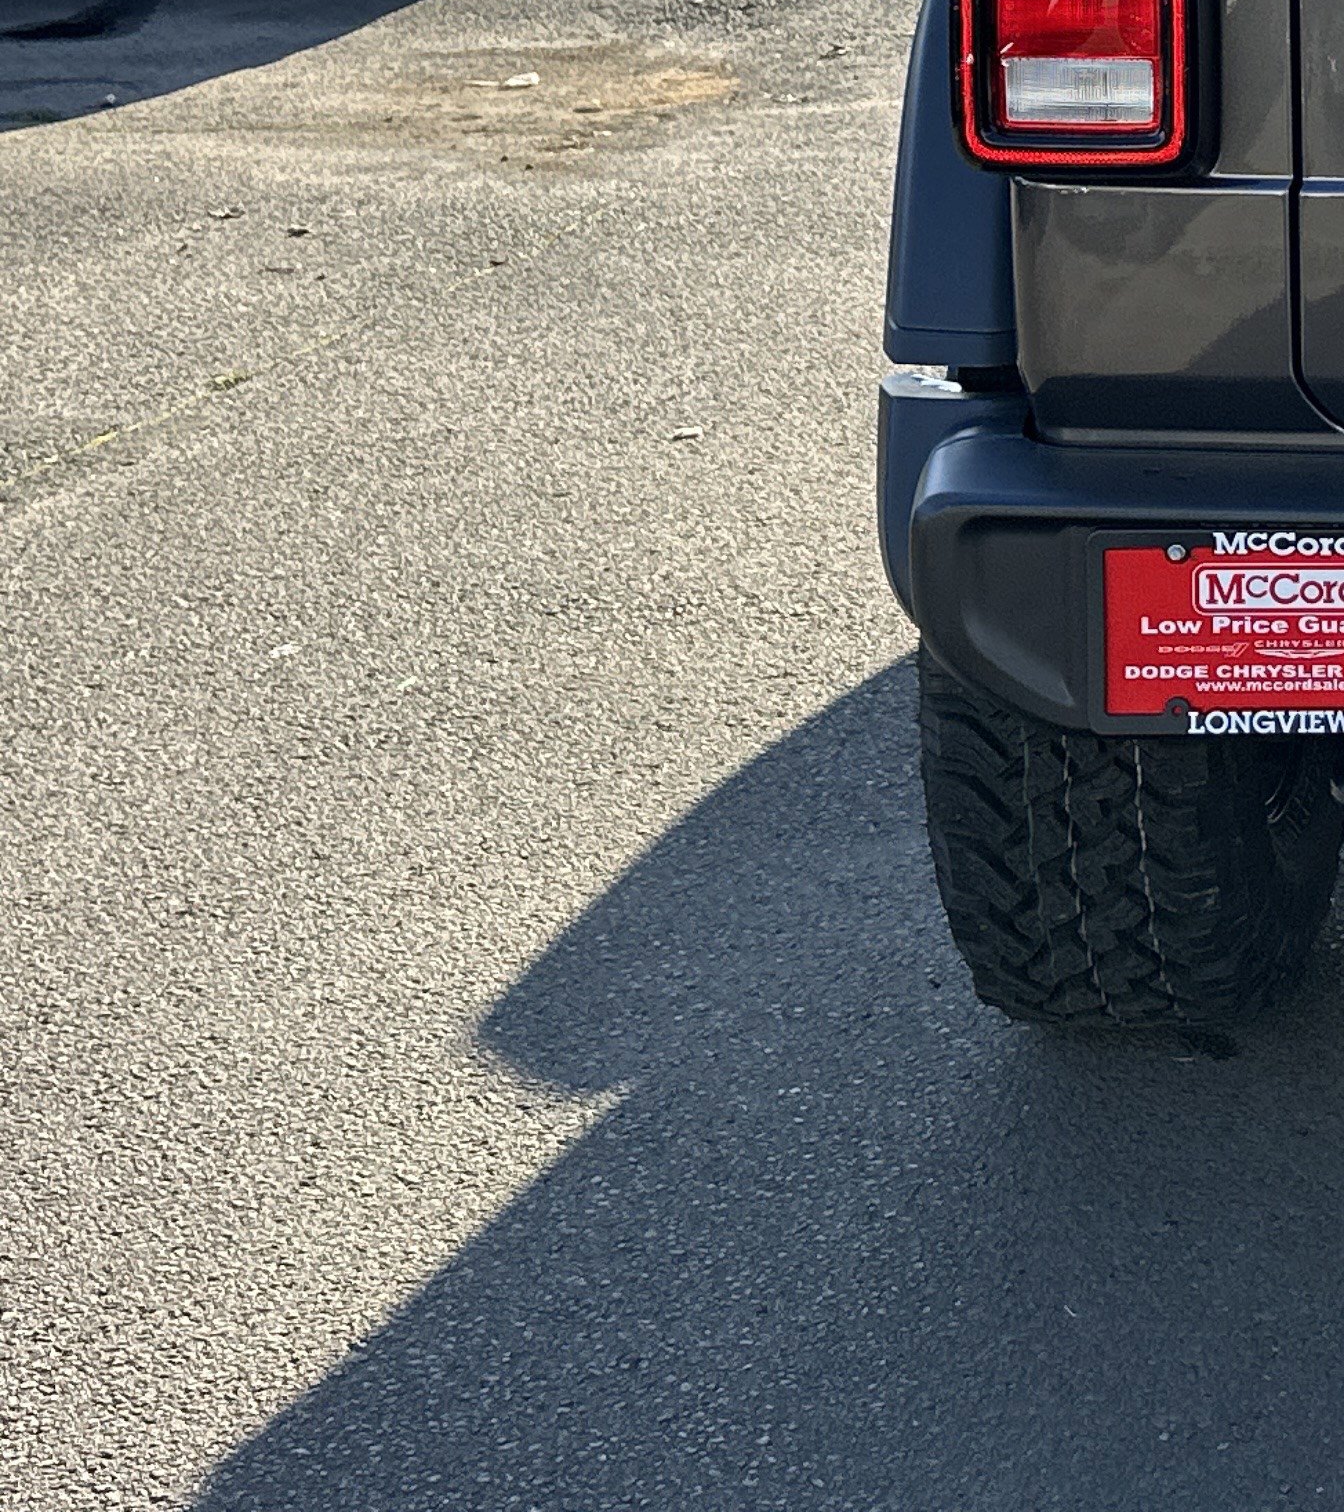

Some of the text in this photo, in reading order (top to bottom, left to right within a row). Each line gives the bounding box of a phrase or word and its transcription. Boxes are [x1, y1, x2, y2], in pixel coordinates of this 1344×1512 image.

[1140, 616, 1202, 635] Low
[1212, 615, 1289, 635] Price
[1124, 665, 1209, 679] DODGE
[1215, 664, 1343, 679] CHRYSLER
